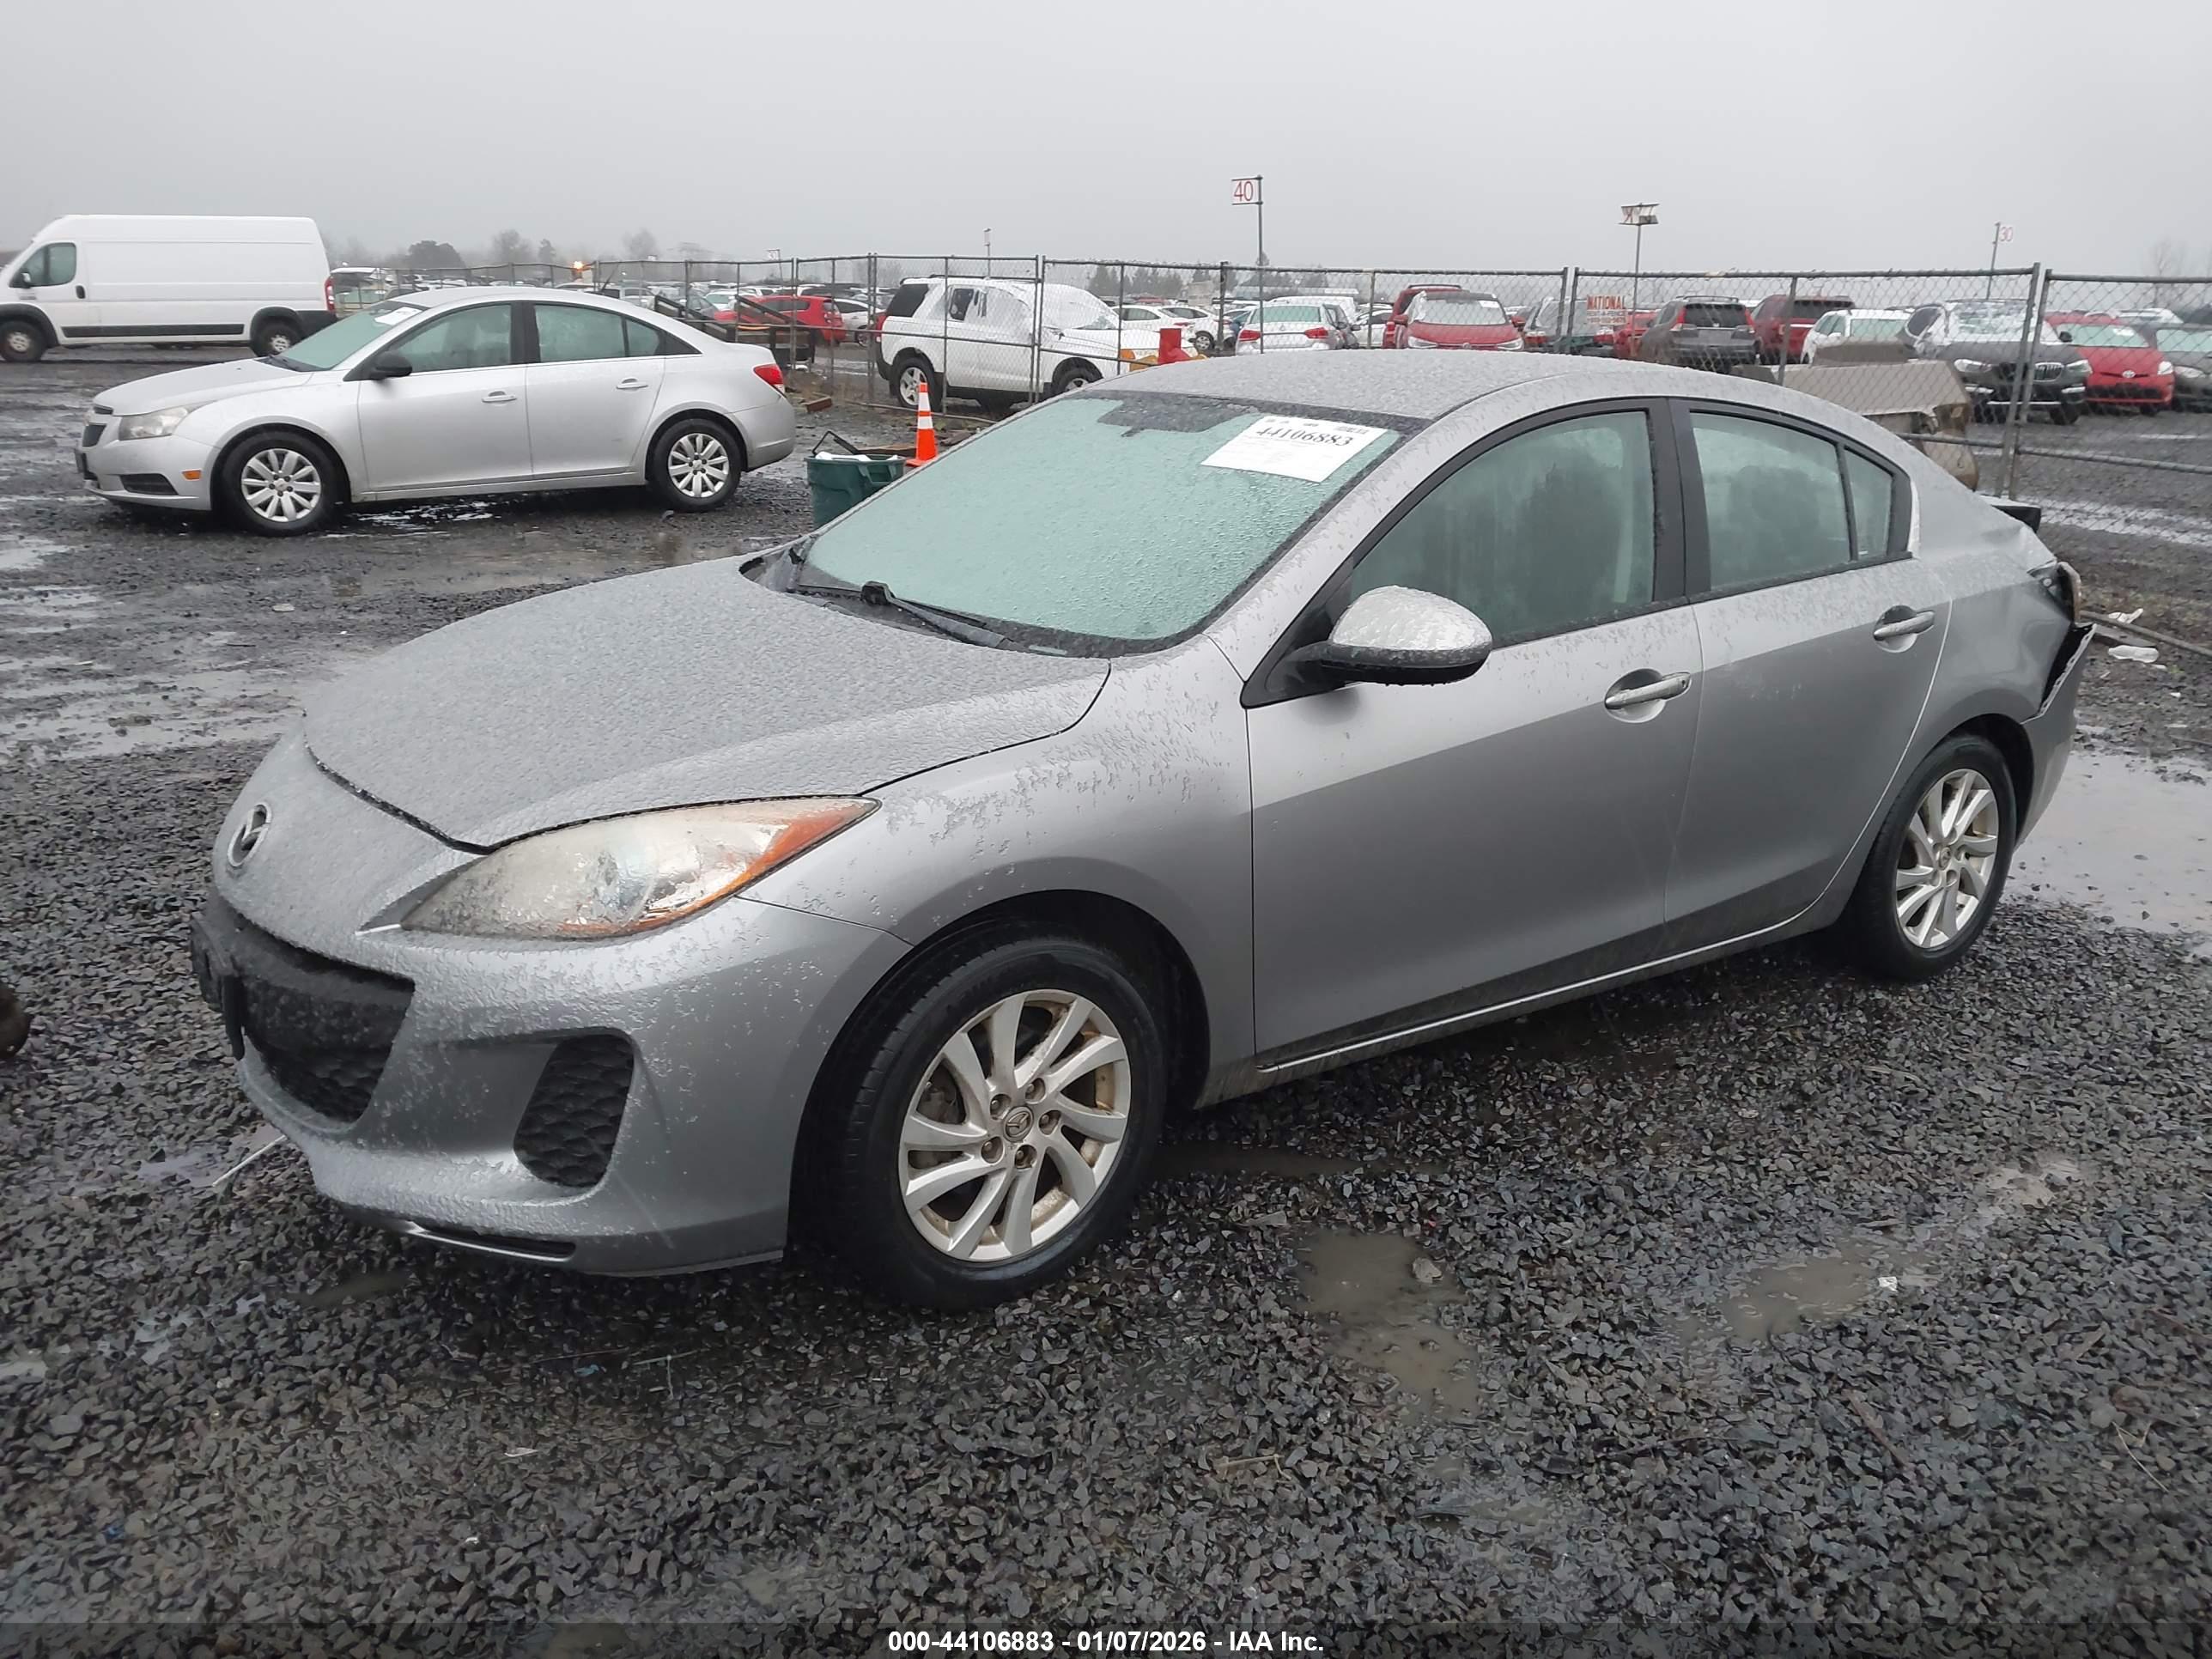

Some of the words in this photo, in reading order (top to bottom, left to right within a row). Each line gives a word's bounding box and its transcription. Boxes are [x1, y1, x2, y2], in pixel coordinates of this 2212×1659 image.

[1234, 180, 1254, 202] 40
[2000, 226, 2013, 241] 30
[1587, 295, 1626, 310] NATIONAL
[1255, 427, 1354, 447] 44106883
